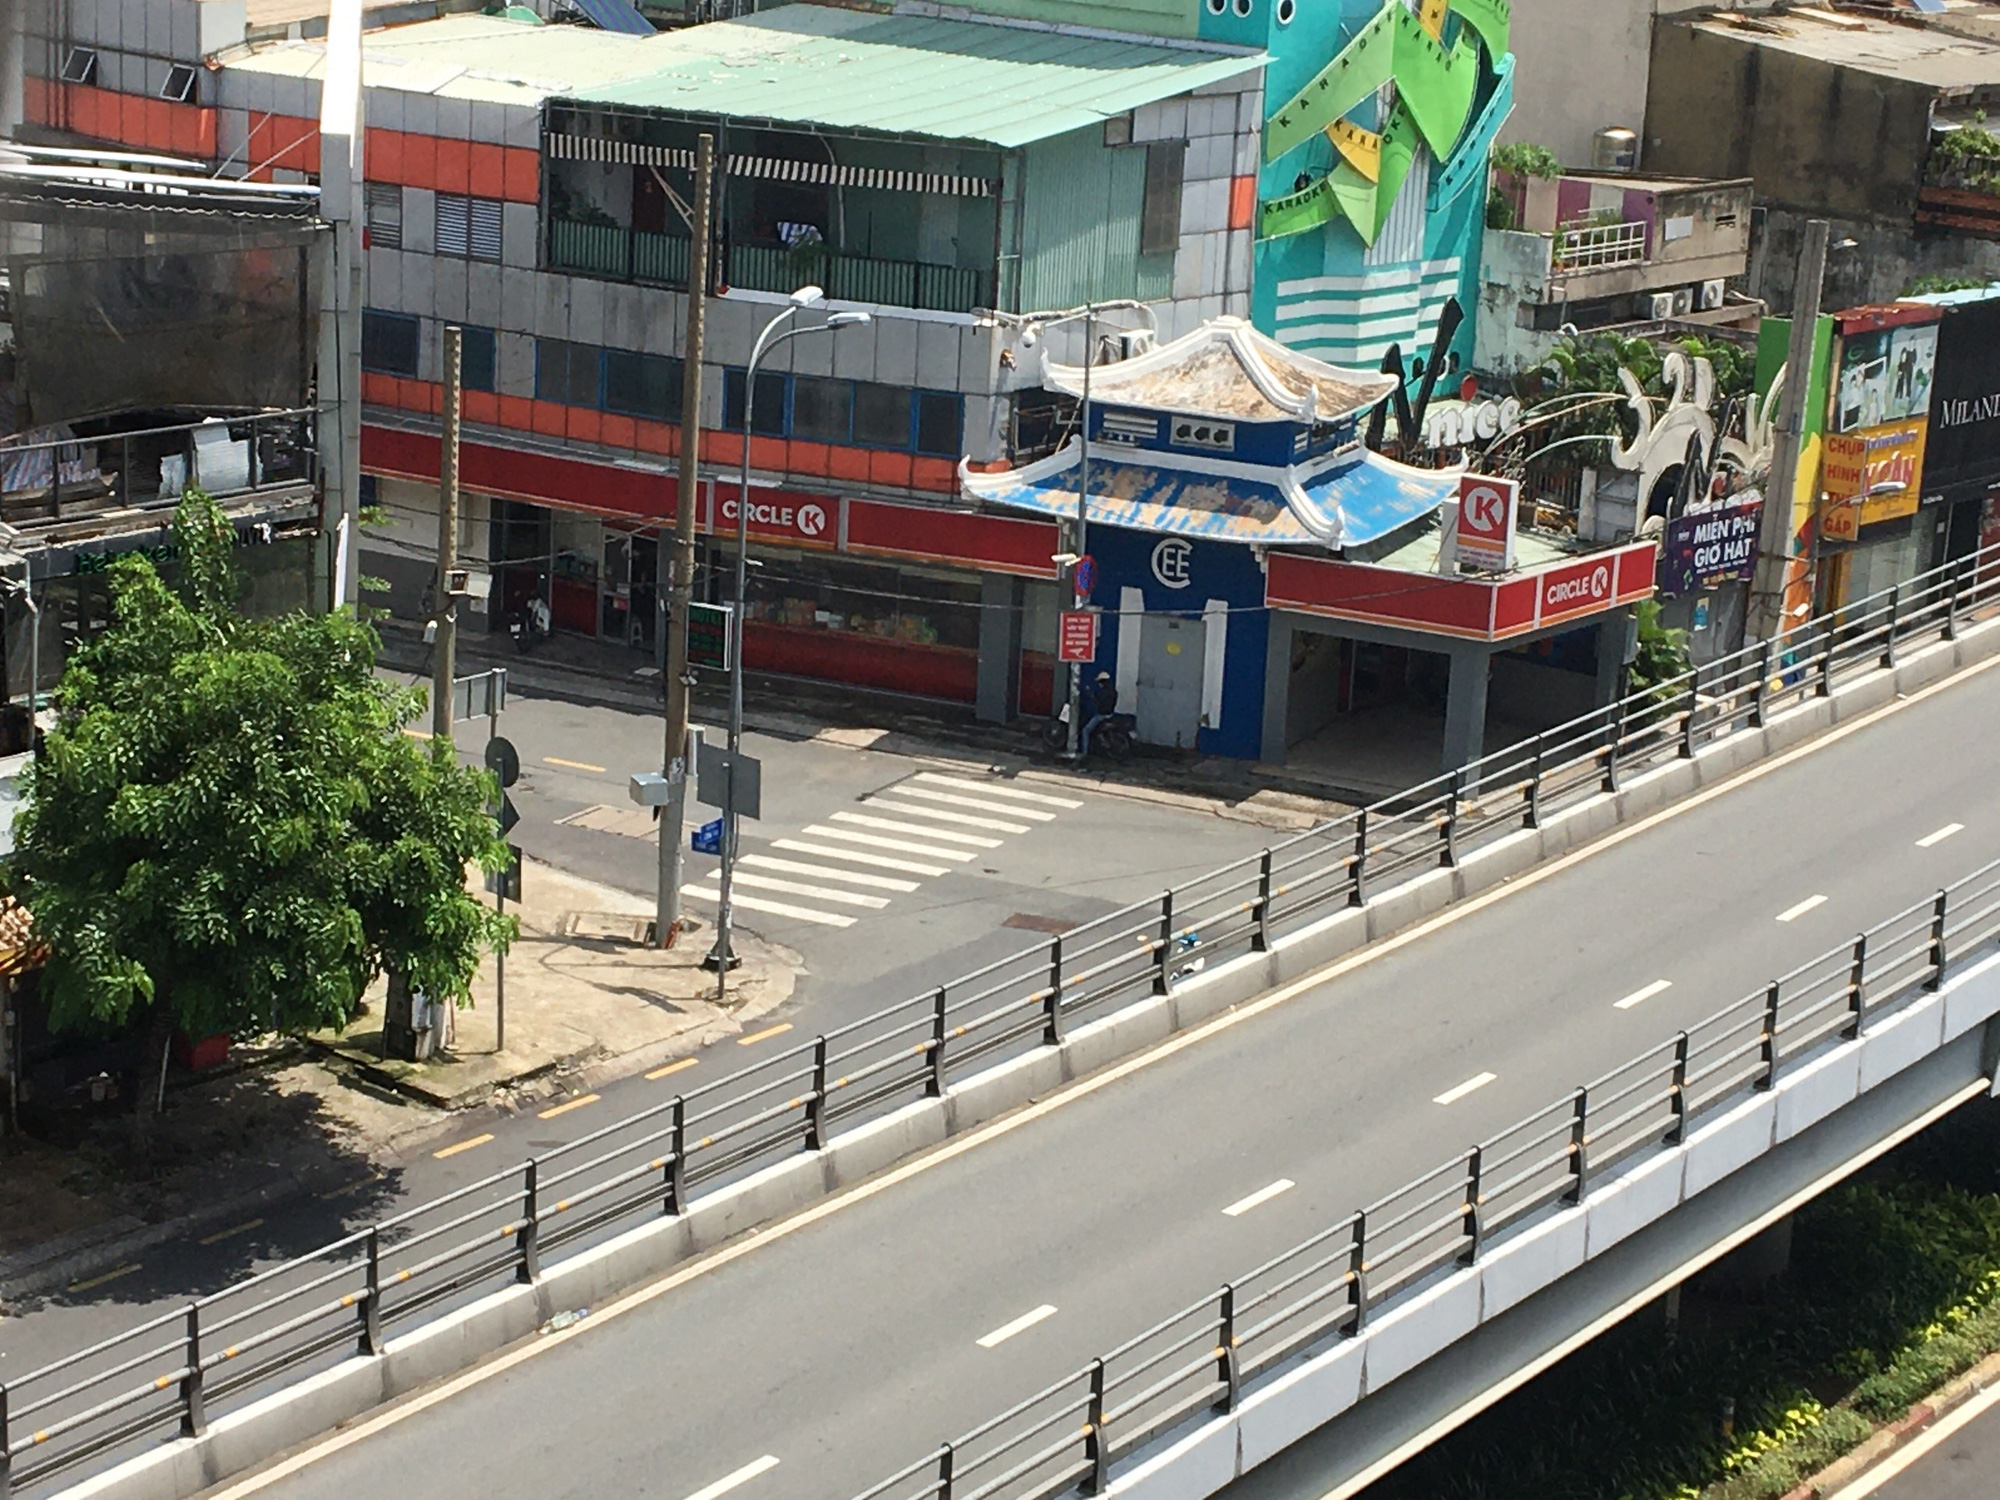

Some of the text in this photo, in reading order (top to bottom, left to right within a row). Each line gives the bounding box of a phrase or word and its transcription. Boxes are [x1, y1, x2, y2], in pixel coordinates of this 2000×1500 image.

[722, 499, 826, 536] CIRCLE K
[1464, 486, 1504, 532] K
[1723, 533, 1753, 562] HÁT
[1547, 565, 1609, 605] CIRCLE K
